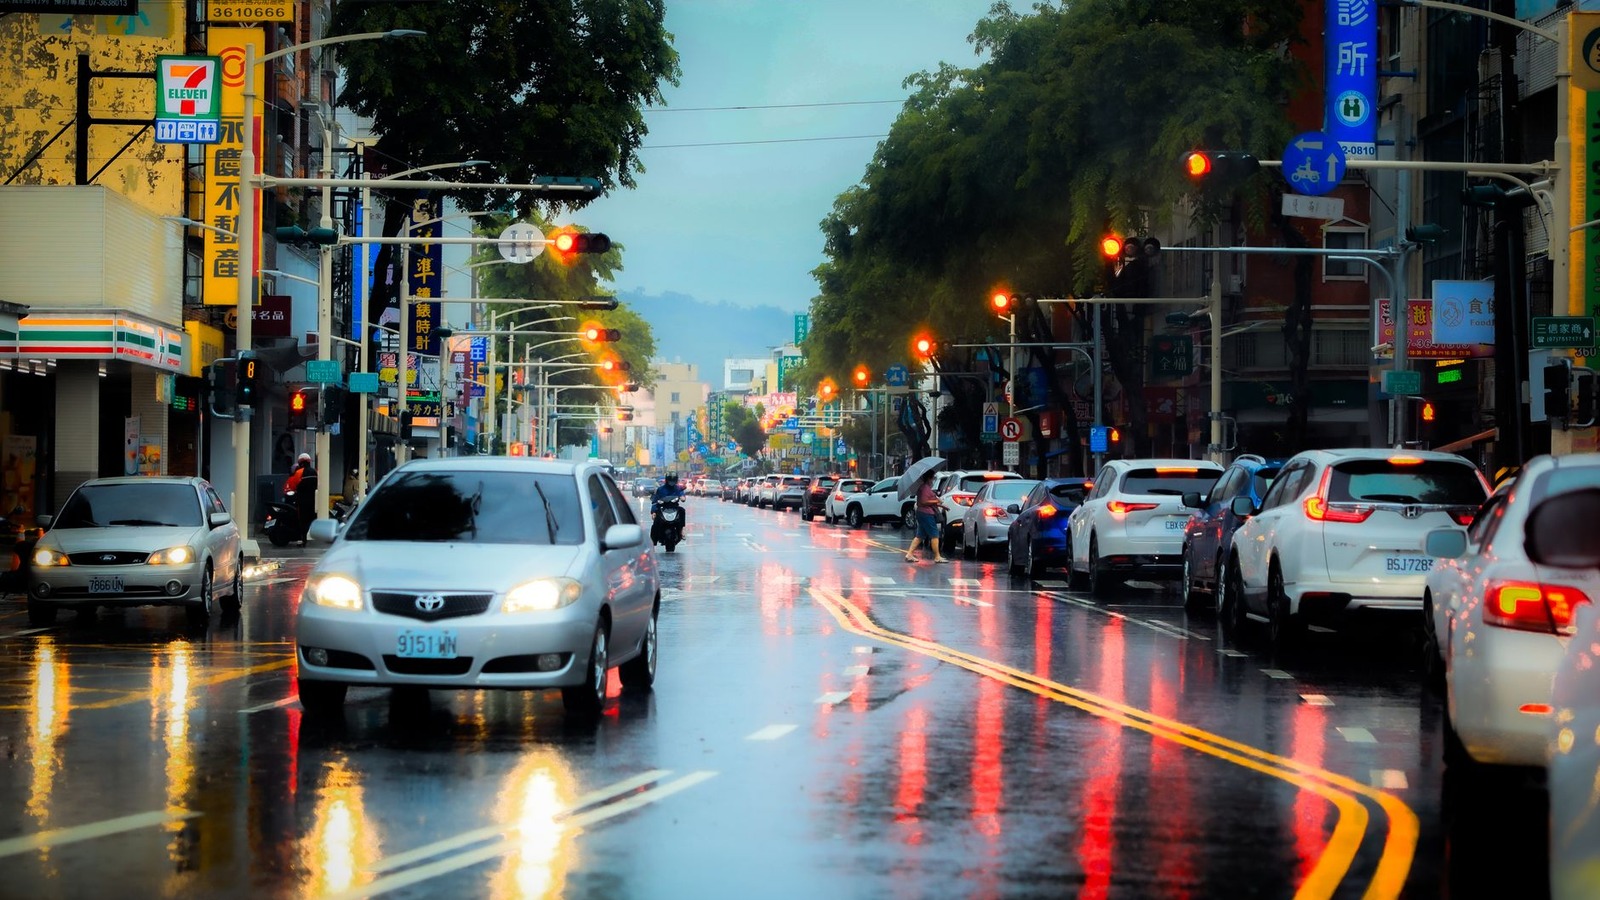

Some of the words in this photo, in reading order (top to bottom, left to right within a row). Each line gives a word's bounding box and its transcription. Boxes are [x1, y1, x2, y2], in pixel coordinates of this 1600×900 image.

[213, 7, 285, 17] 3610666
[170, 65, 207, 115] 7
[247, 361, 255, 379] 8
[89, 579, 111, 591] 7866
